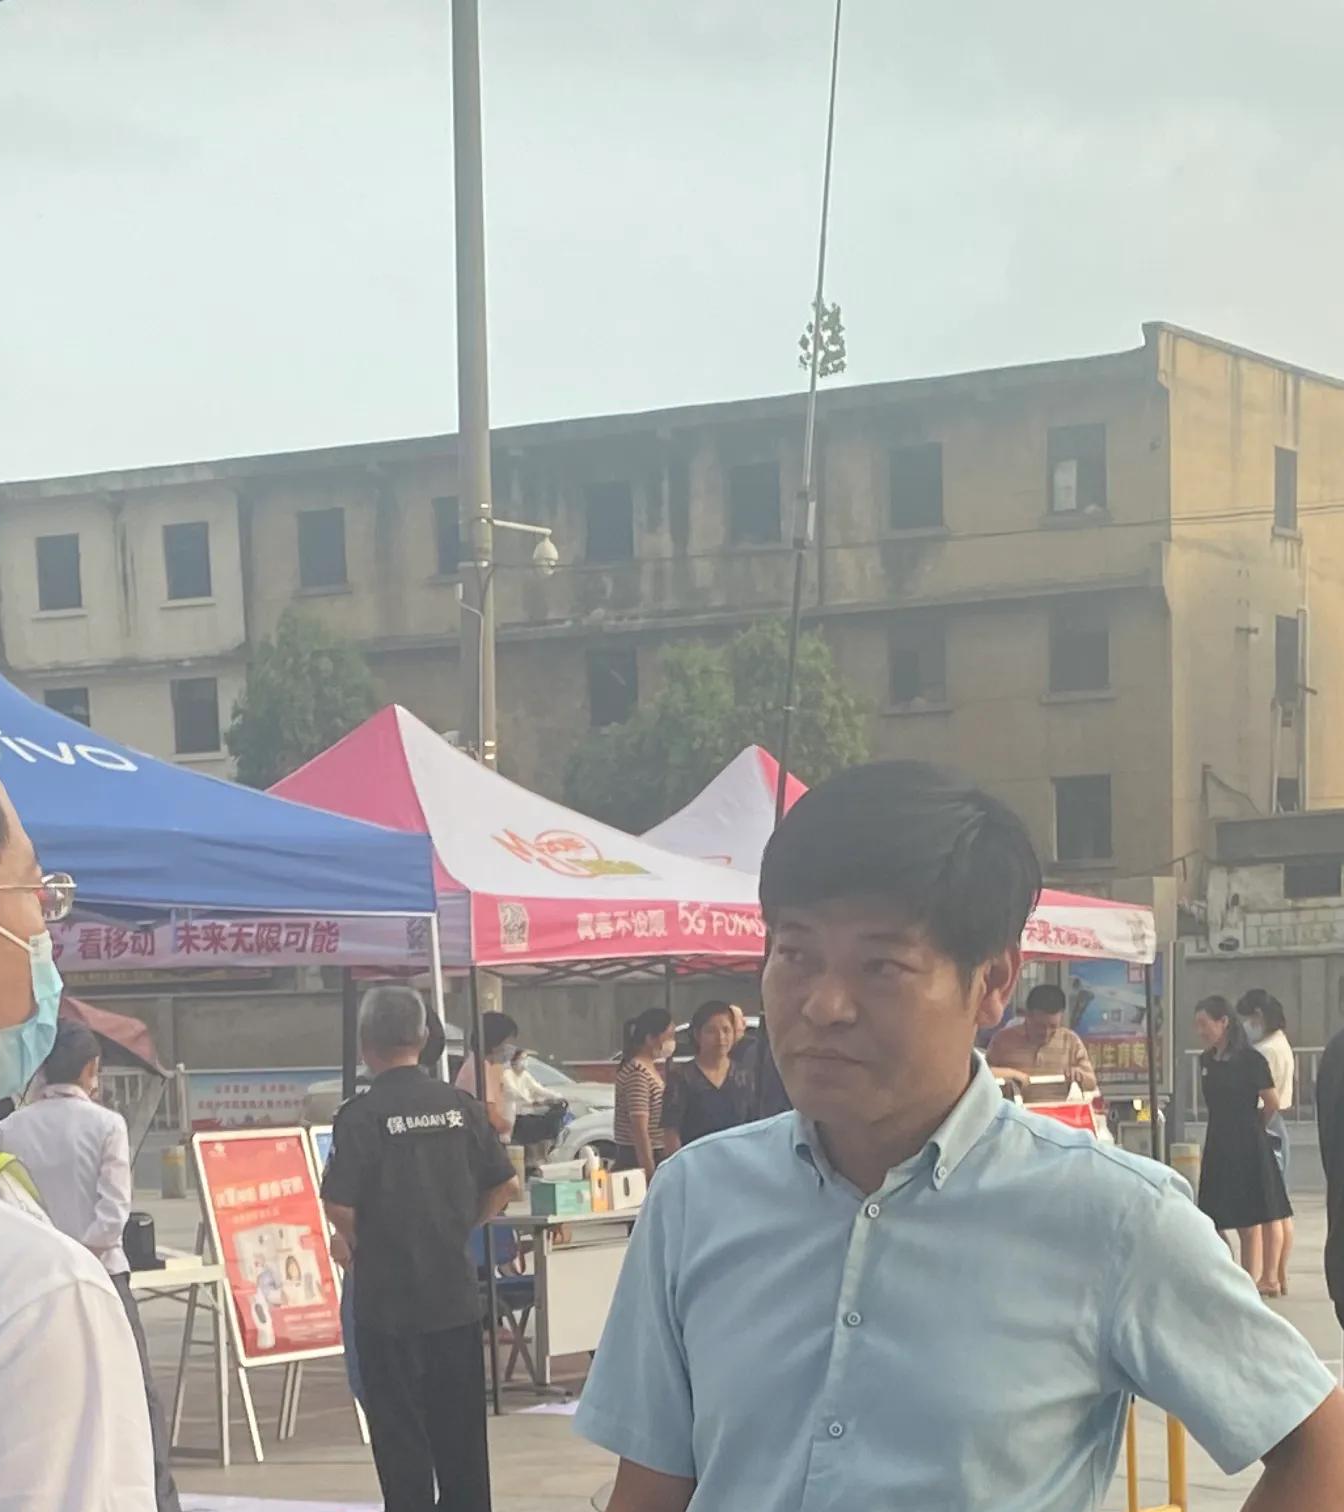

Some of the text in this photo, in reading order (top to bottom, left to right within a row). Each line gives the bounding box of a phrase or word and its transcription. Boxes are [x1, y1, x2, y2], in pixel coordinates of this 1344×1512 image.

[175, 920, 340, 956] 未来无限可能
